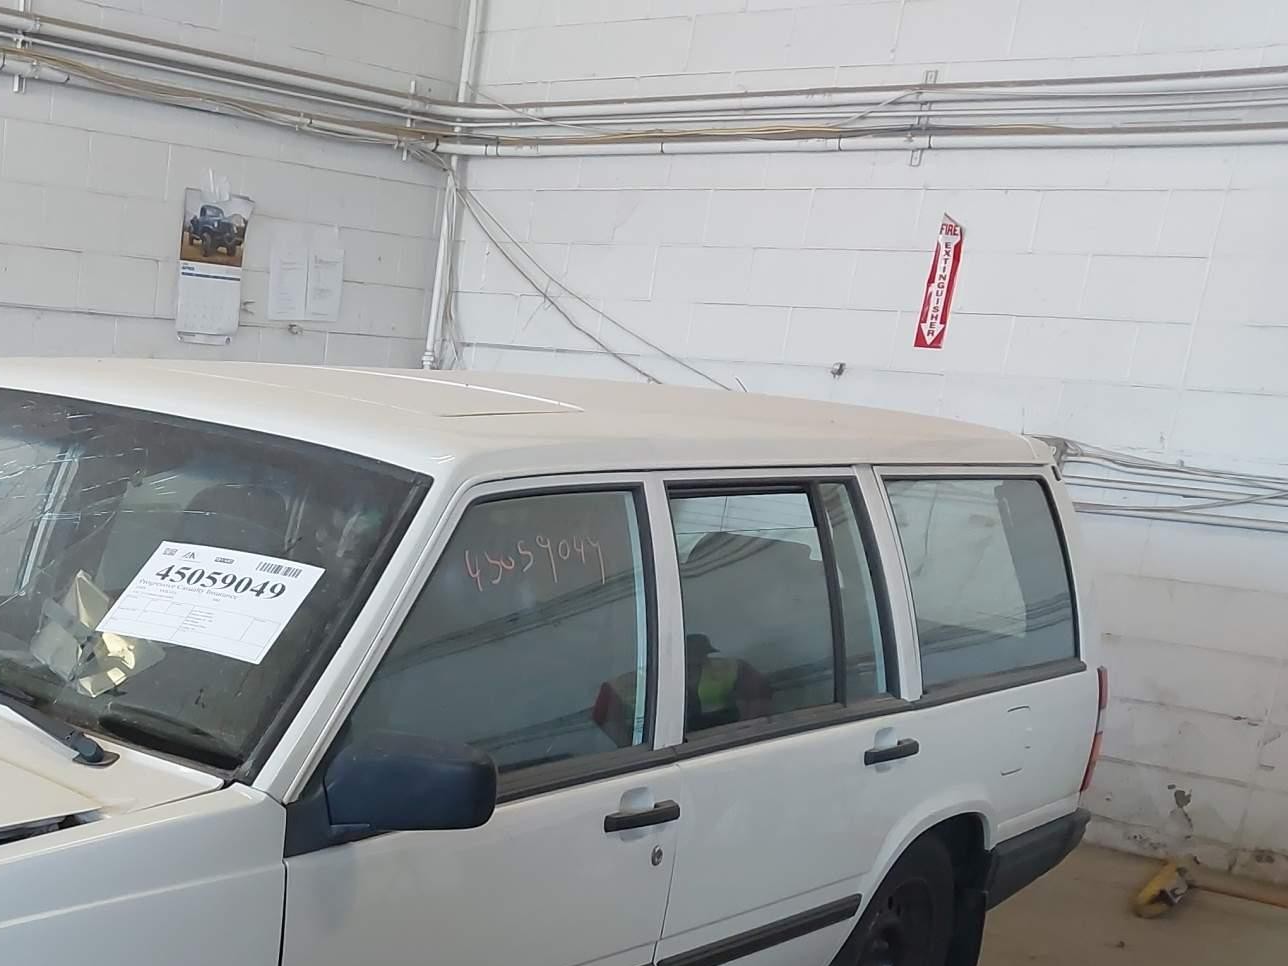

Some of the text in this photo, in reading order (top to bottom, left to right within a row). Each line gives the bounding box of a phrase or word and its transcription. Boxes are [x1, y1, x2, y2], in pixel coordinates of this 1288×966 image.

[939, 223, 959, 236] FIRE
[926, 241, 952, 337] EXTINGUISHER
[155, 564, 286, 600] 45059049
